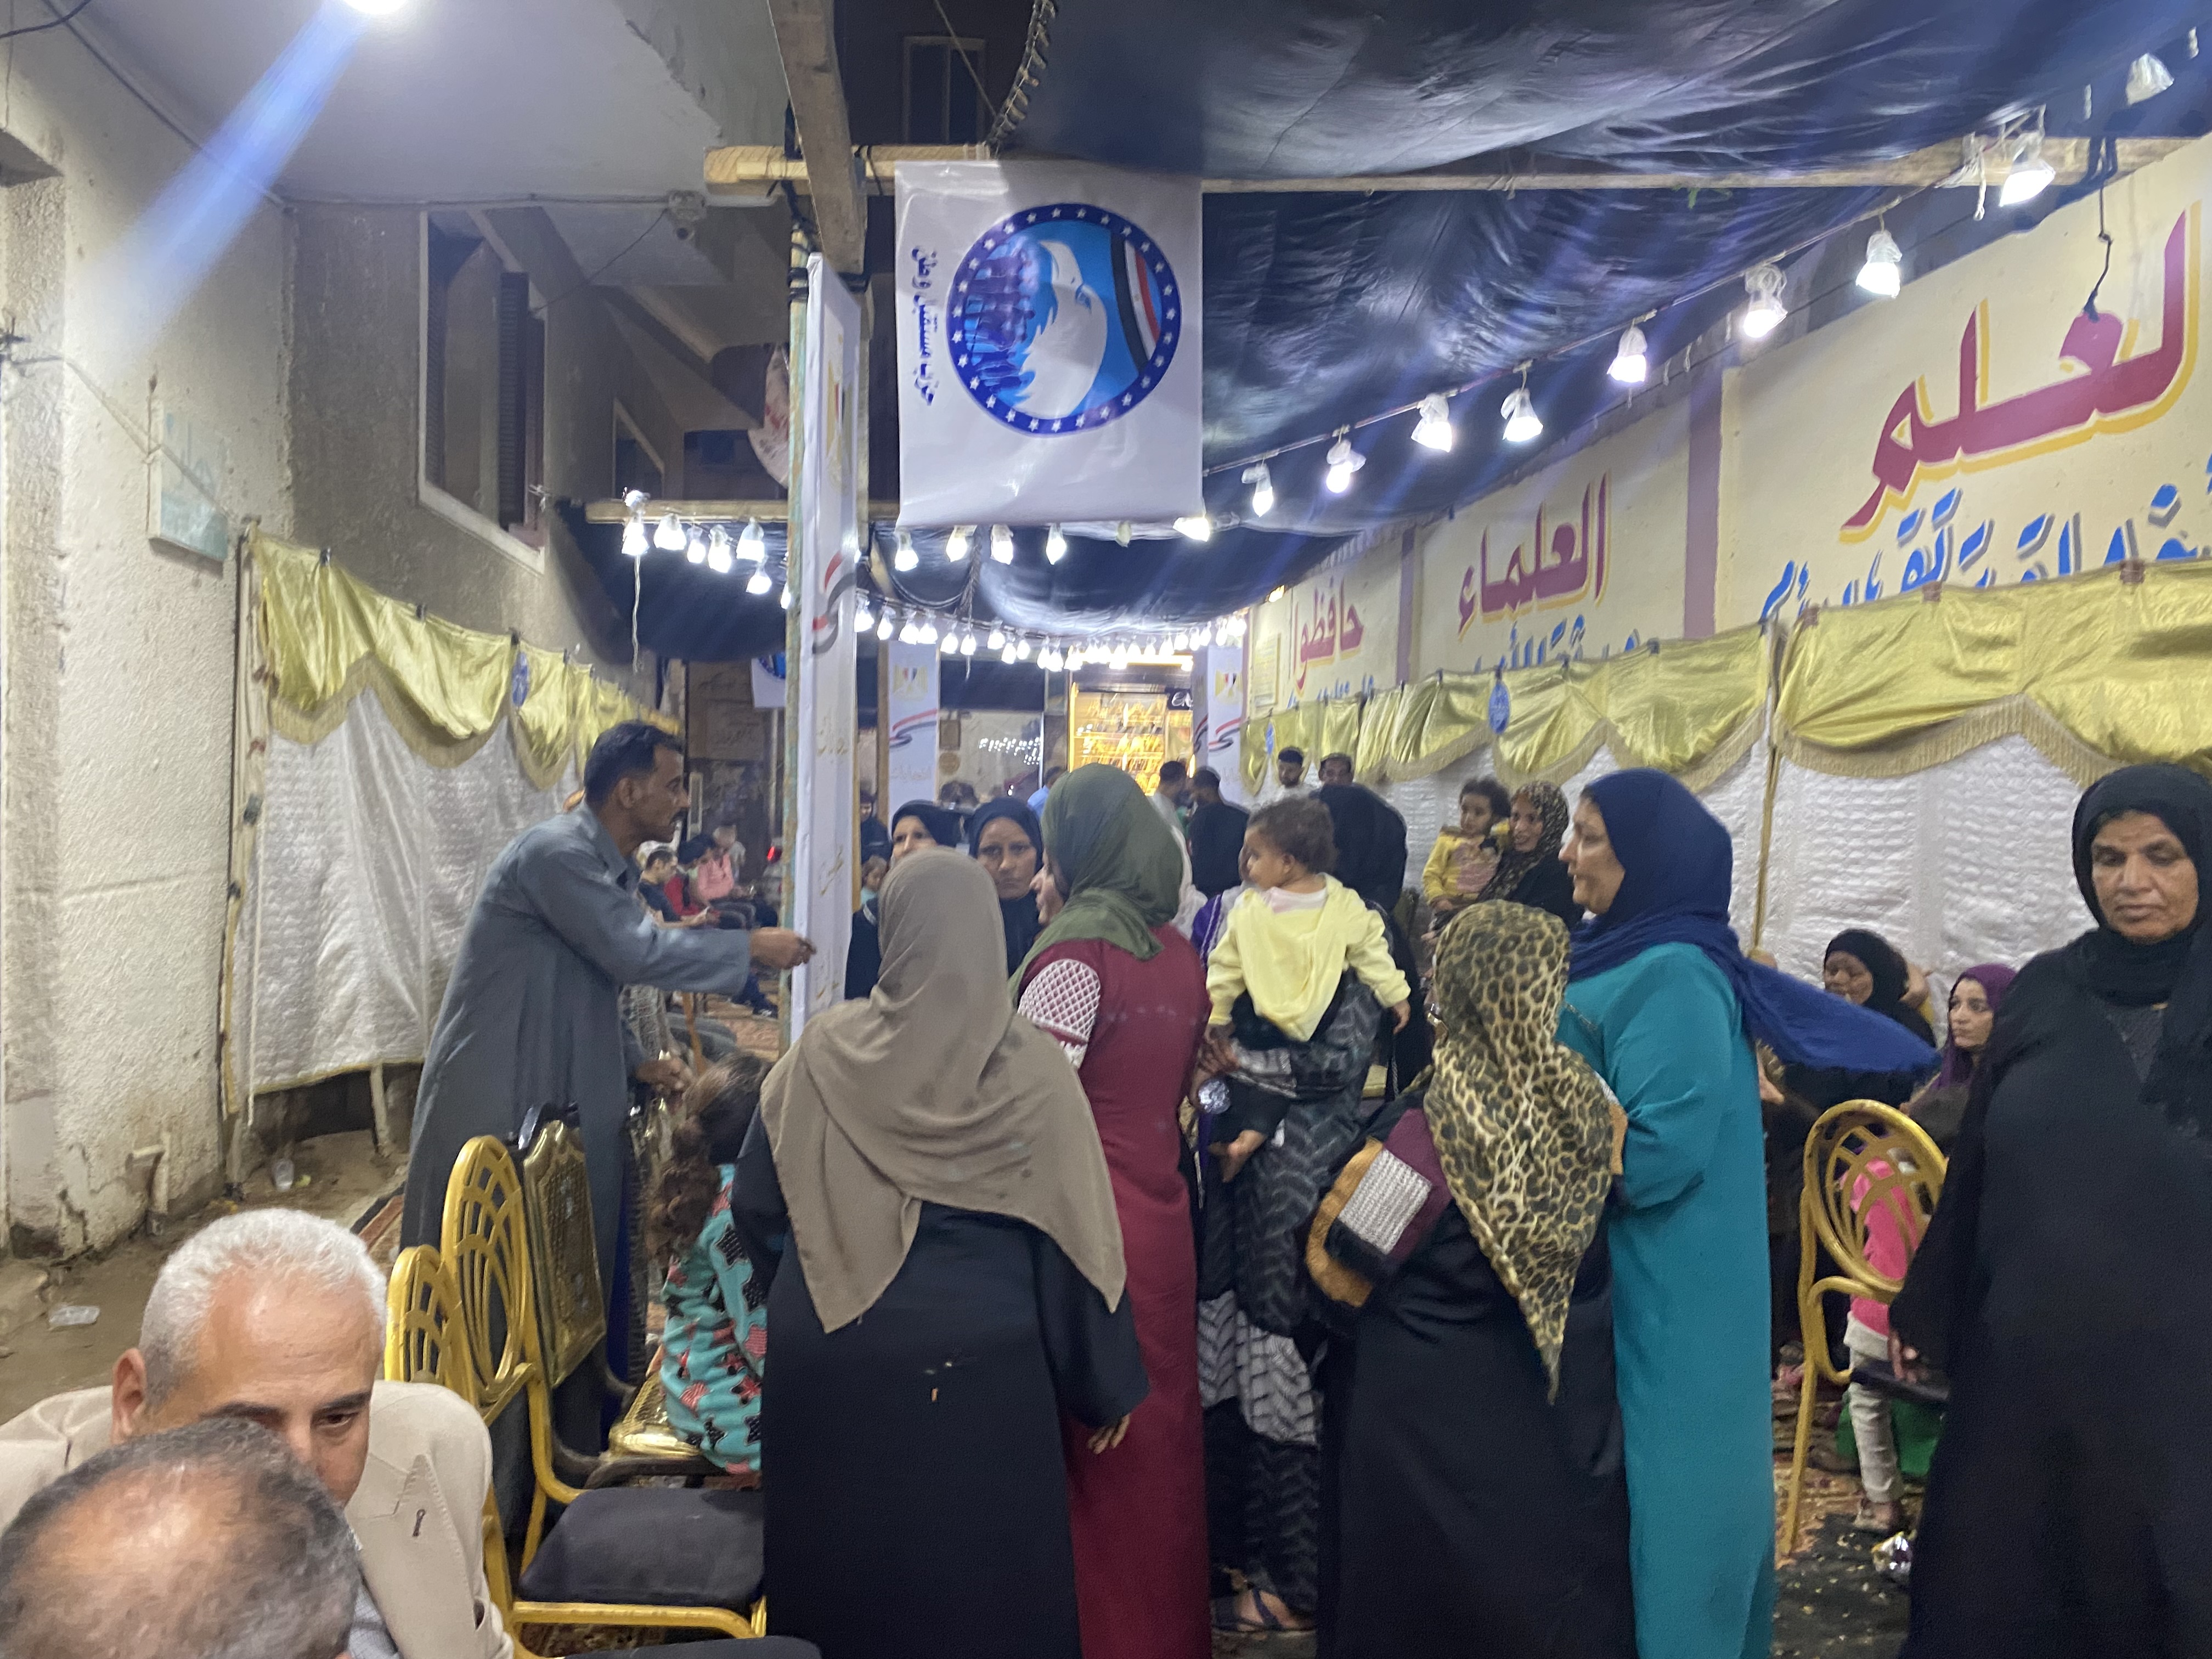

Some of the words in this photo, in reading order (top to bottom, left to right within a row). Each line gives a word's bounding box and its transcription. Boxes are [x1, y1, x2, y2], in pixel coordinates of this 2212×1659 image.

[912, 246, 939, 290] وطن
[912, 292, 939, 359] مستقبل
[913, 363, 940, 406] حزب
[1459, 471, 1610, 637] العلماء
[1293, 576, 1364, 691] حافظوا
